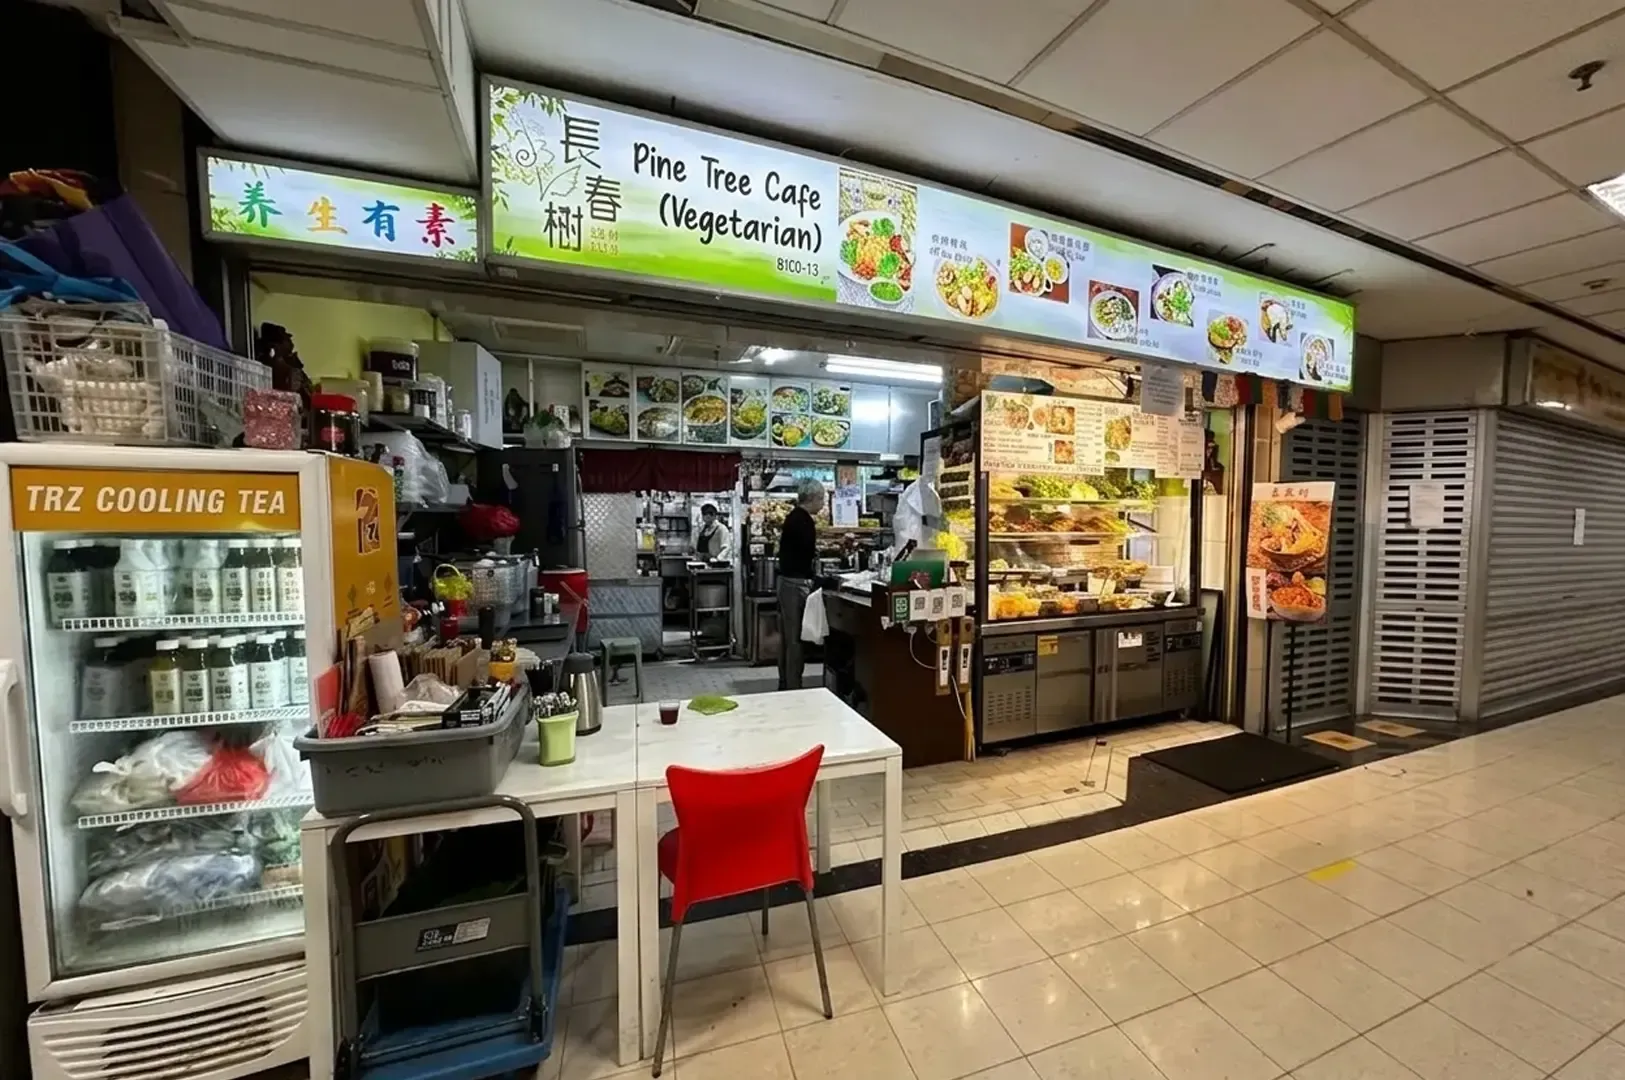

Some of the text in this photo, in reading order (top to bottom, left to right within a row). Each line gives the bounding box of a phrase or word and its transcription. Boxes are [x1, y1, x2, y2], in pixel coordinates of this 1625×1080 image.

[633, 142, 822, 218] Pine Tree Cafe
[238, 180, 456, 248] 养生有素
[659, 193, 822, 254] (Vegetarian)
[26, 485, 286, 515] TRZ COOLING TEA
